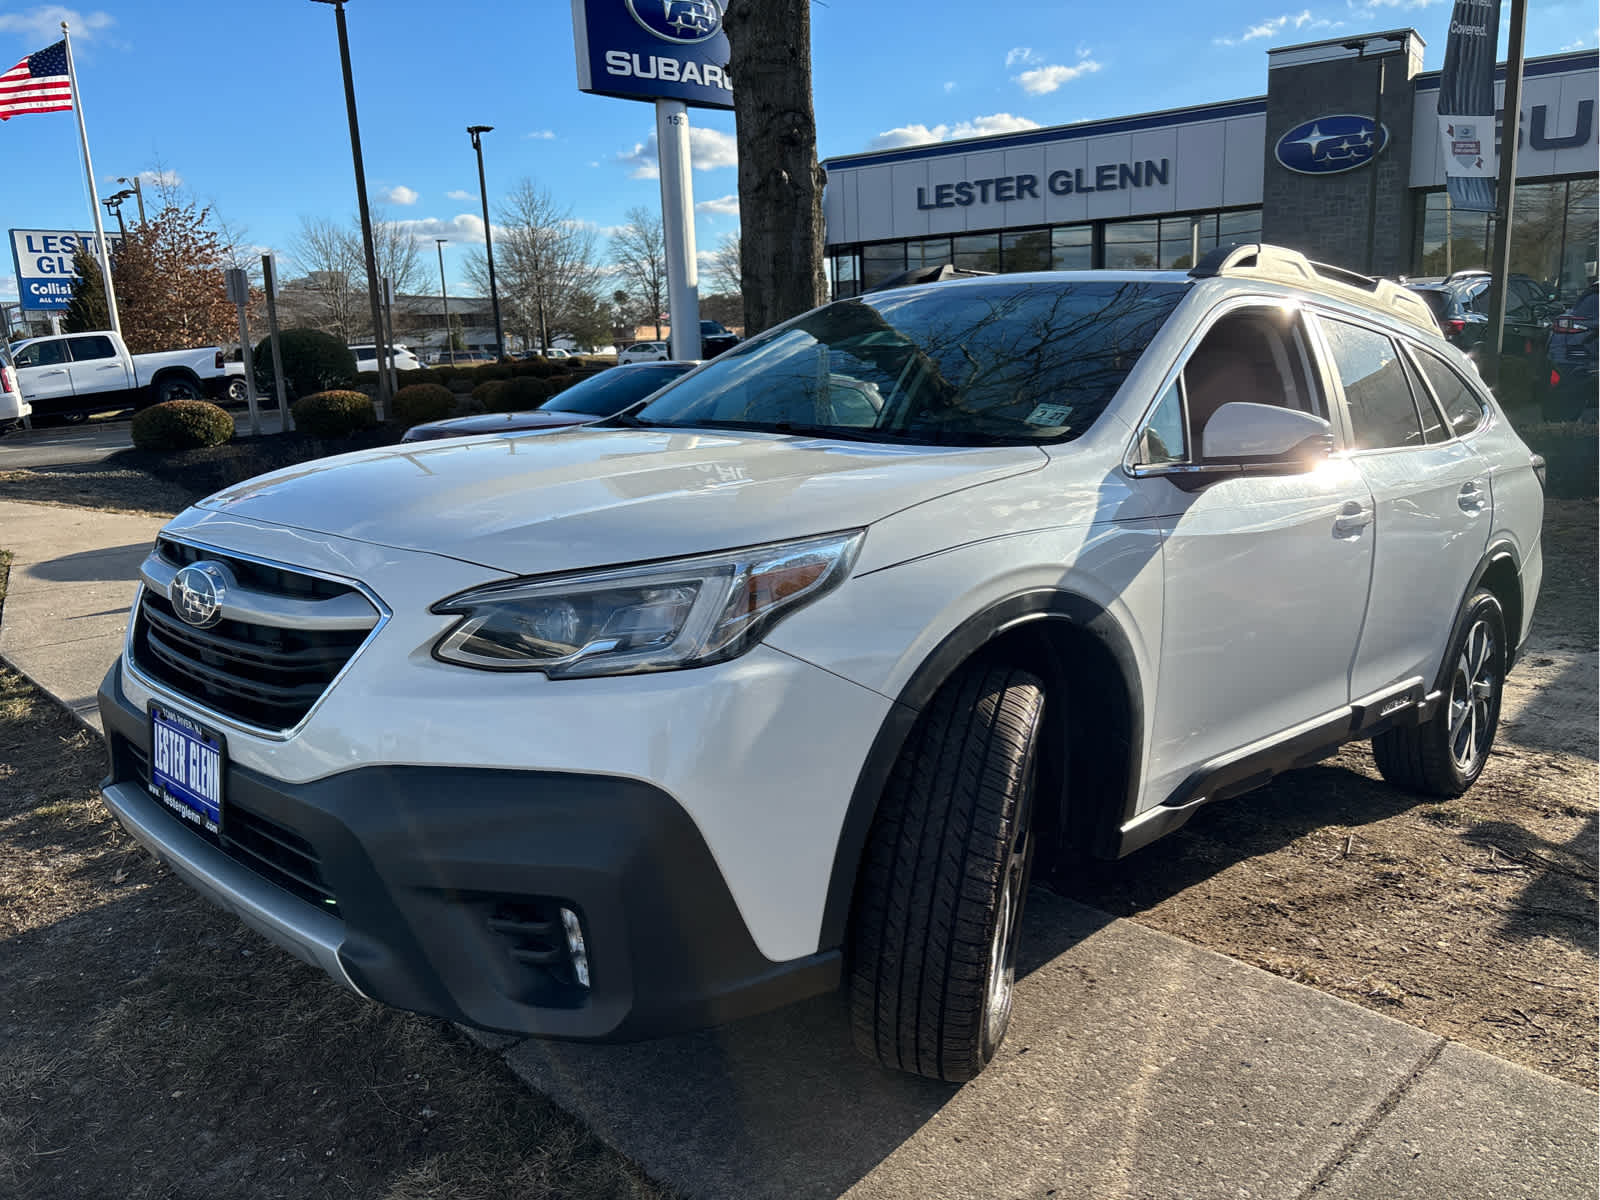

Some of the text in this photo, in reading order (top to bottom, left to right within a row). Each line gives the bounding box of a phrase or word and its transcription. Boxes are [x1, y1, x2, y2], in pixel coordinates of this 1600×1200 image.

[1450, 20, 1487, 36] Covered.
[1495, 99, 1594, 152] U
[917, 158, 1169, 211] LESTER GLENN
[30, 283, 72, 295] Collisi
[154, 722, 220, 804] LESTER GLENN
[163, 793, 201, 825] lesterglenn
